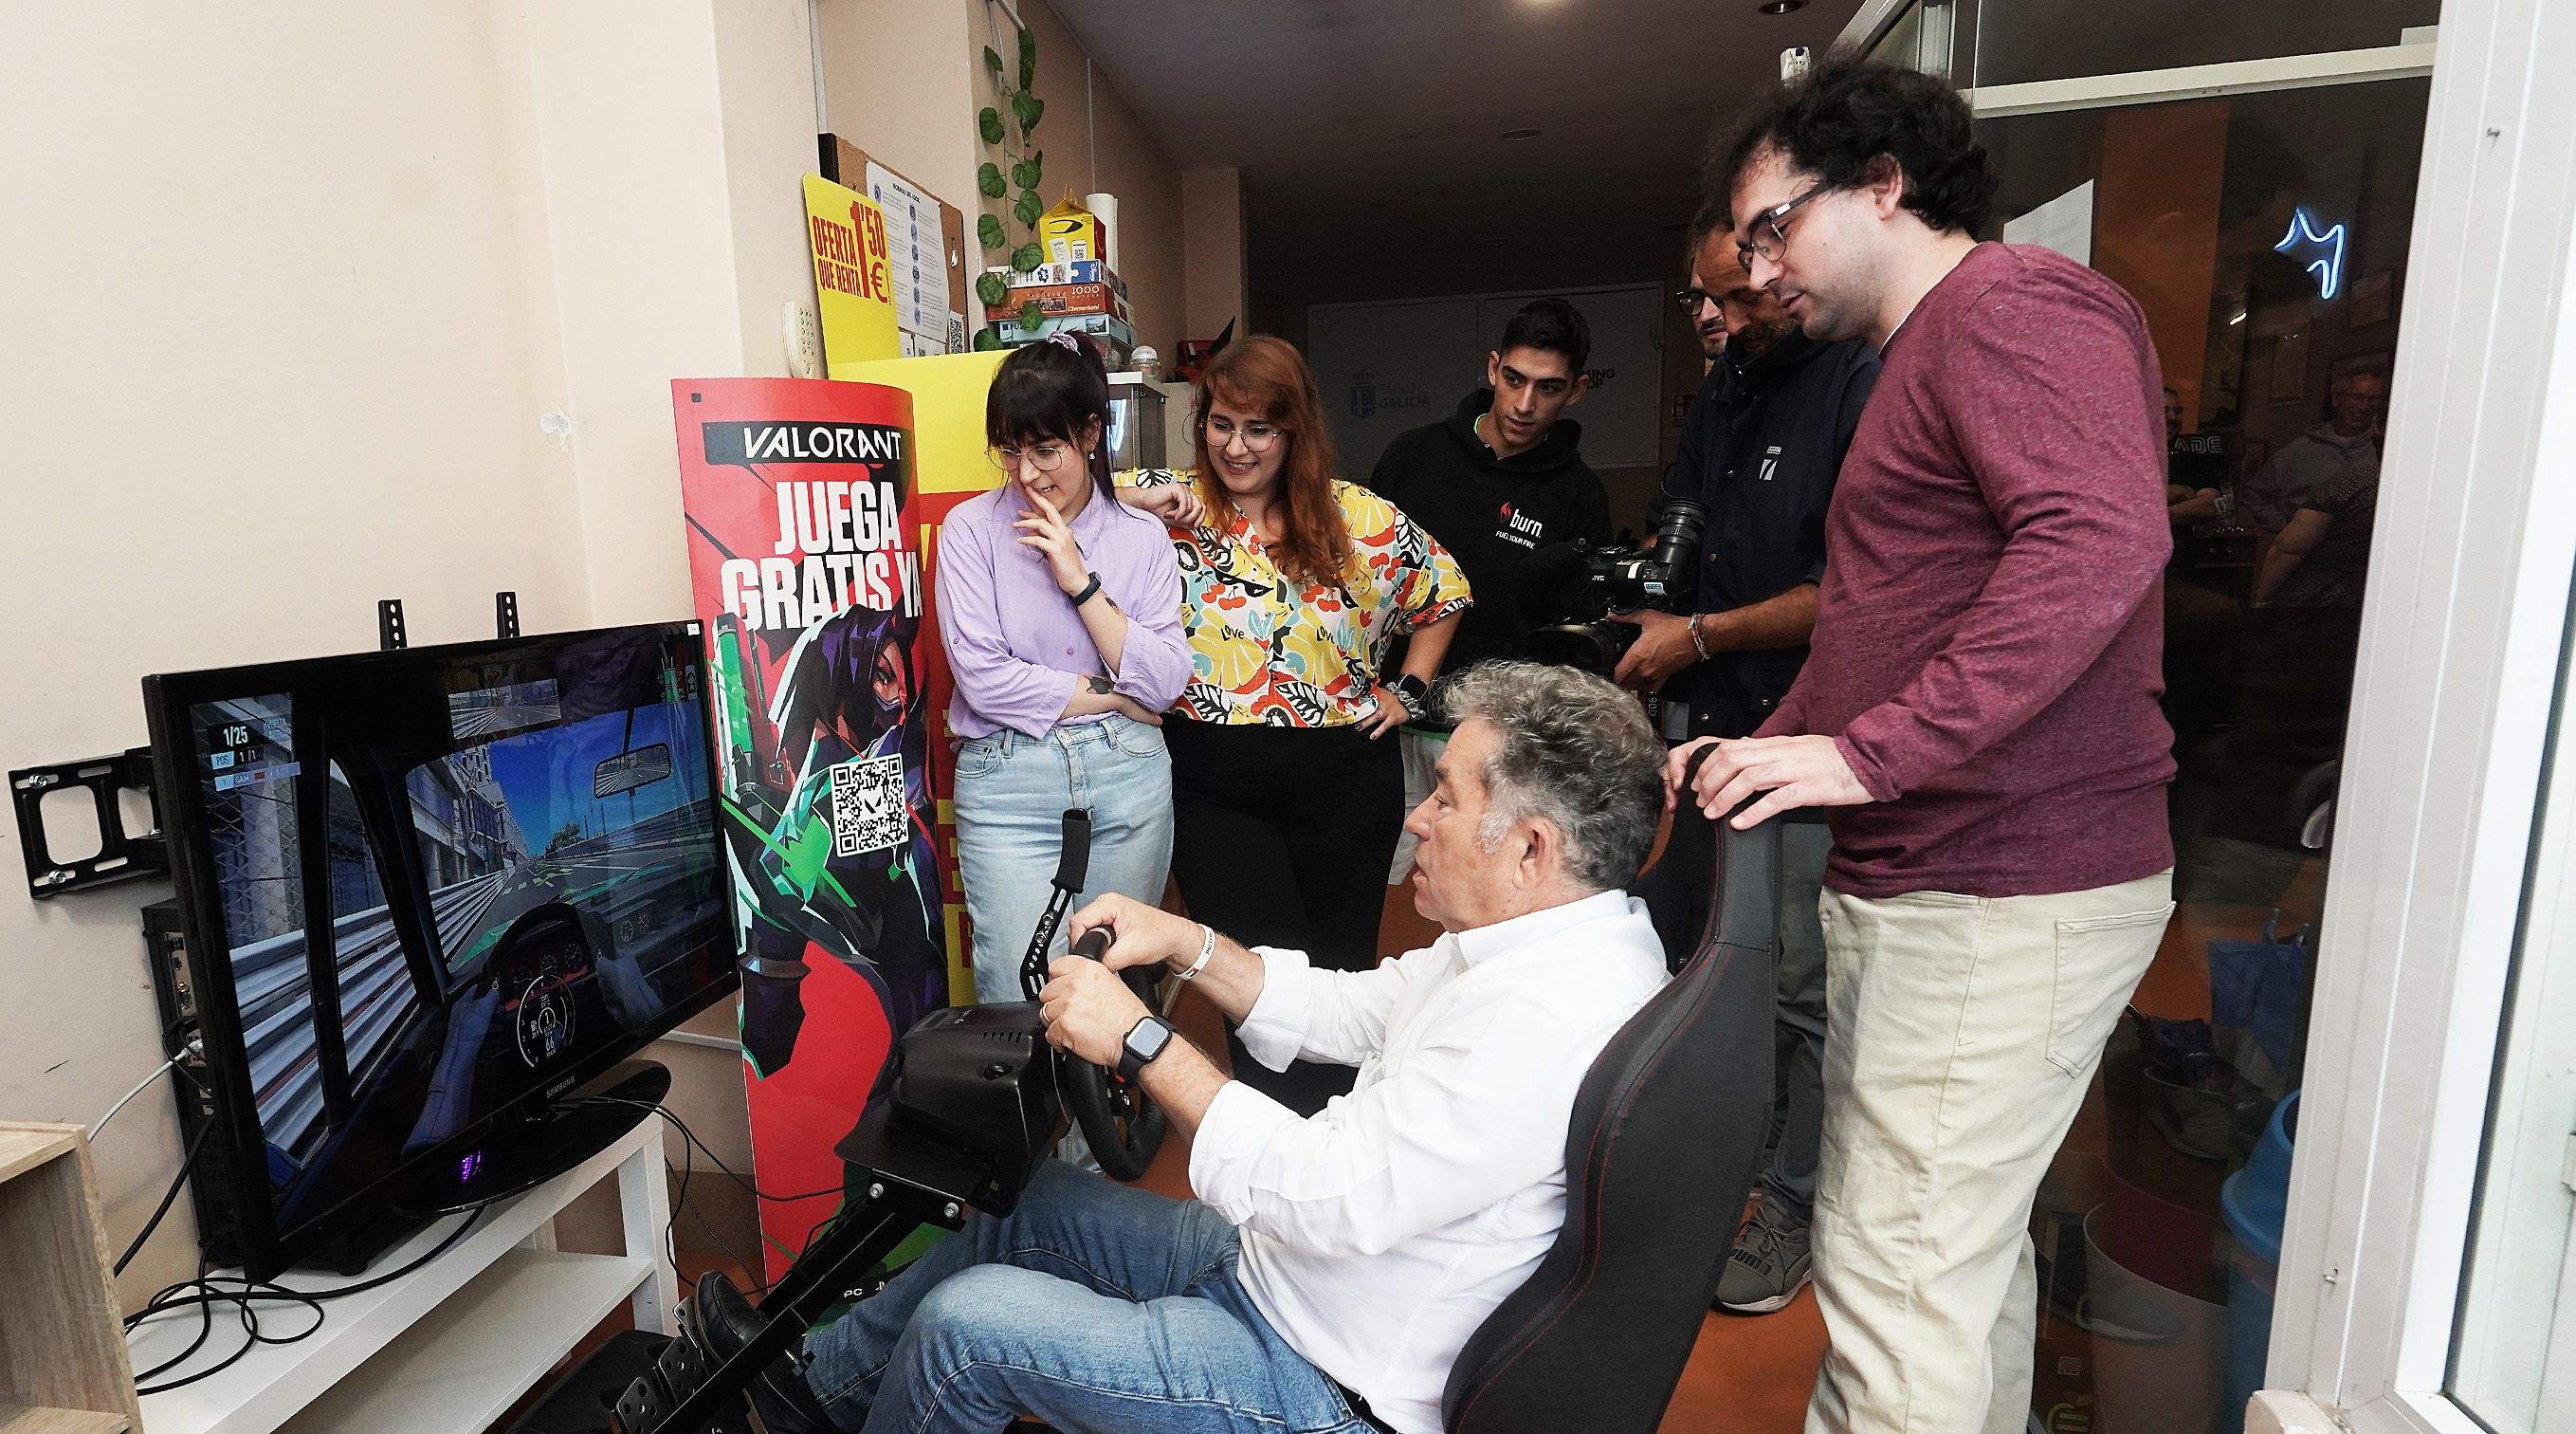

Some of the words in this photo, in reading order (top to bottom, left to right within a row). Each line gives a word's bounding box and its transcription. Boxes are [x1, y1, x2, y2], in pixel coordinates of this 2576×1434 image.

[812, 215, 858, 267] OFERTA
[818, 258, 836, 291] QUE
[835, 265, 862, 298] RENTA
[869, 261, 887, 303] €
[1071, 285, 1100, 295] 1000
[1379, 395, 1430, 409] GALICIA
[743, 427, 902, 461] VALORANT
[774, 481, 902, 554] JUEGA
[1495, 531, 1509, 541] FUEL
[1509, 535, 1524, 545] YOUR
[1523, 539, 1536, 550] FIRE
[721, 552, 893, 632] GRATIS
[895, 552, 923, 617] YA
[223, 726, 248, 747] 1/25
[216, 755, 229, 766] POS
[546, 1076, 575, 1098] SAMSUNG
[1729, 1247, 1772, 1276] PUMA
[844, 1288, 863, 1298] PC
